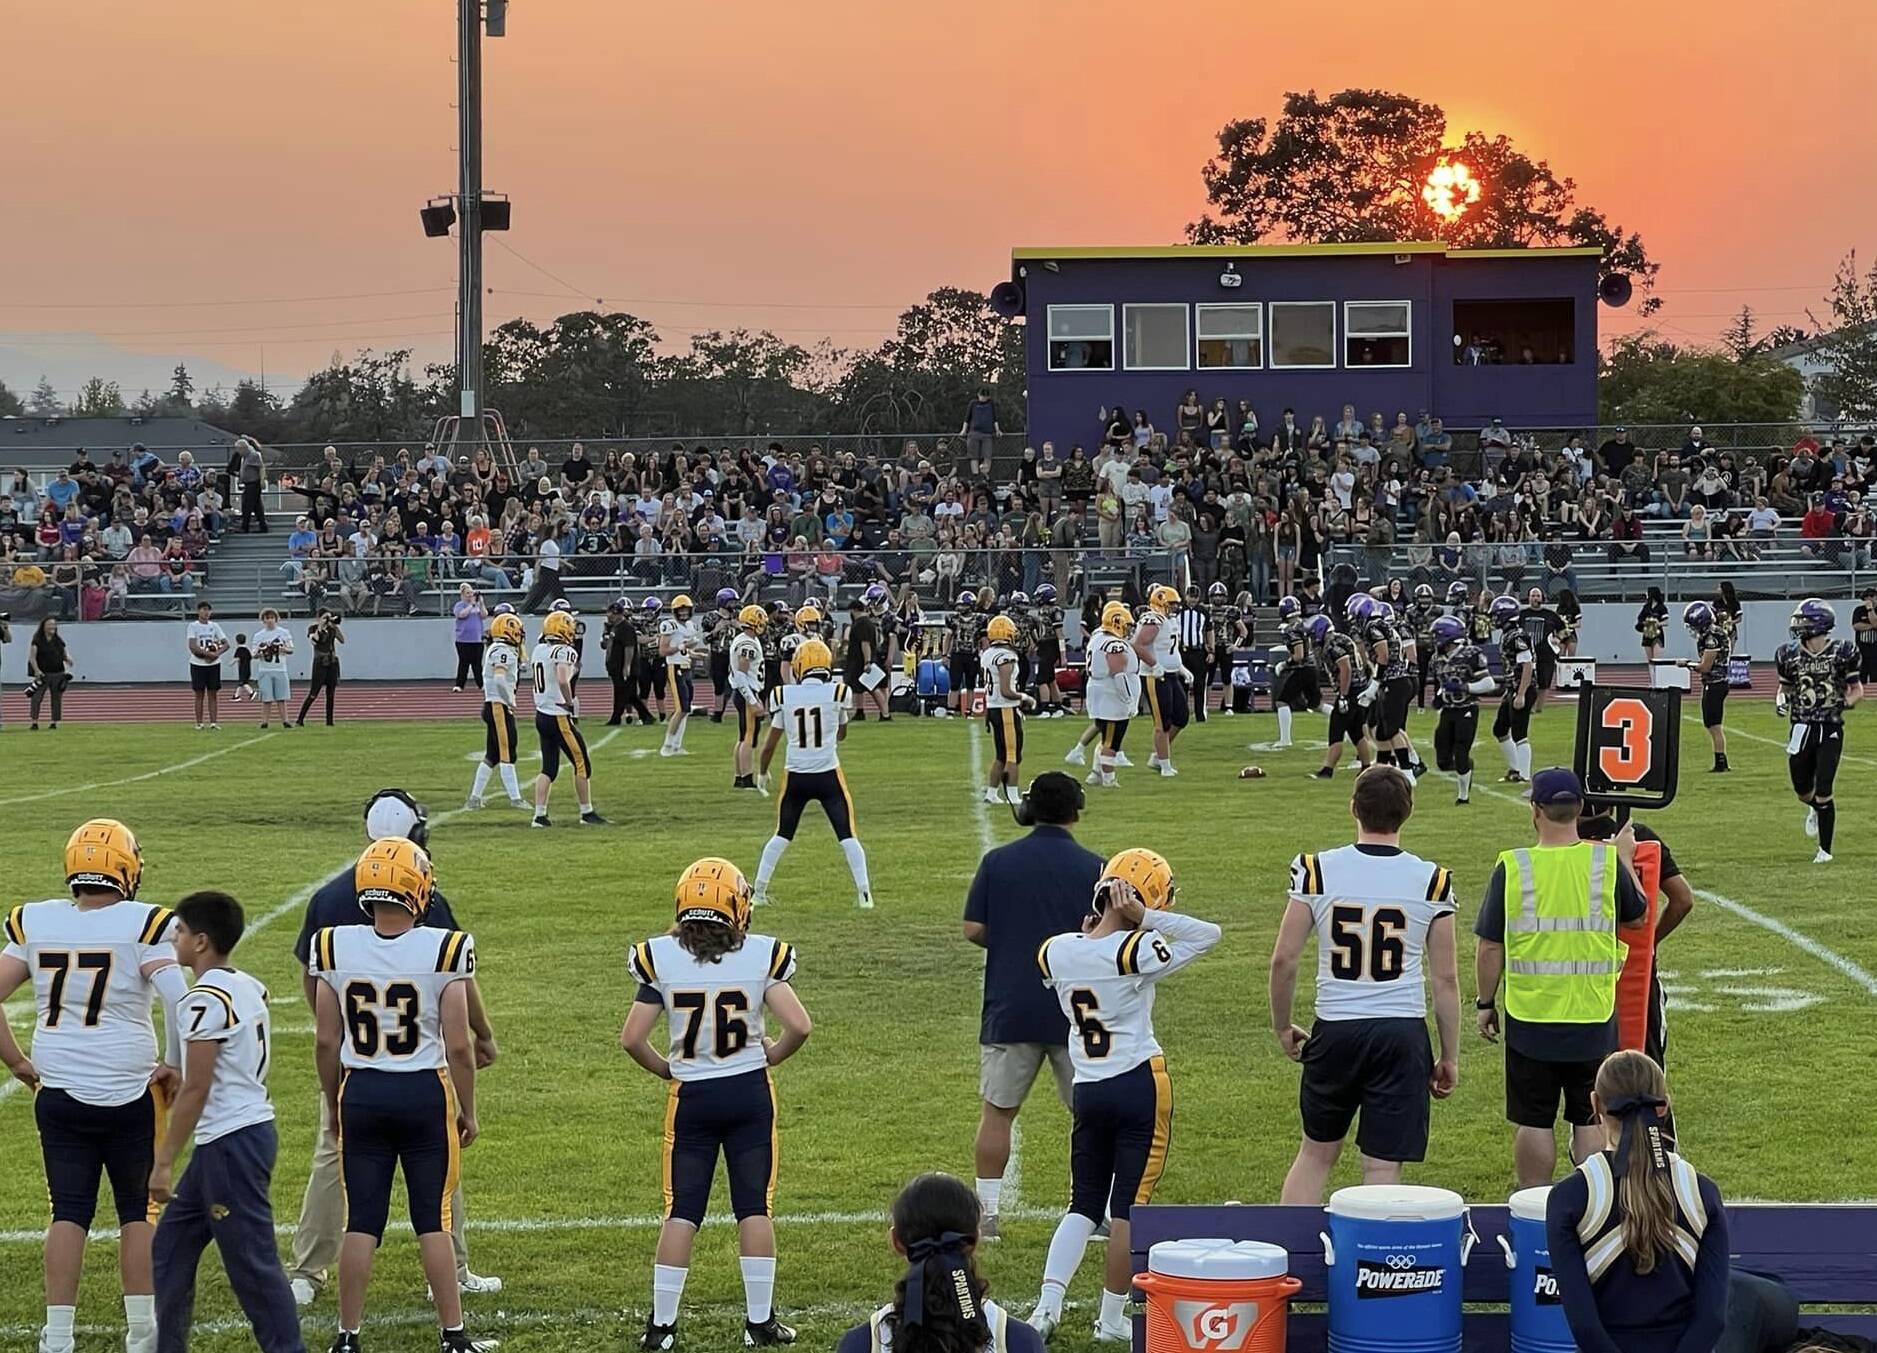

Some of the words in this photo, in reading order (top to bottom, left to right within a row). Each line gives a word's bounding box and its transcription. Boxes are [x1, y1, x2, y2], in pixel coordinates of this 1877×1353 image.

[588, 536, 599, 552] 3
[500, 654, 508, 664] 9
[793, 706, 823, 749] 11
[1598, 697, 1653, 784] 3
[1151, 939, 1170, 964] 6
[1330, 903, 1407, 983] 56
[36, 949, 115, 1030] 77
[190, 1005, 207, 1032] 7
[344, 978, 422, 1060] 63
[670, 987, 753, 1061] 76
[1069, 987, 1113, 1060] 6
[951, 1268, 976, 1320] SPARTANS
[1199, 1308, 1229, 1341] G
